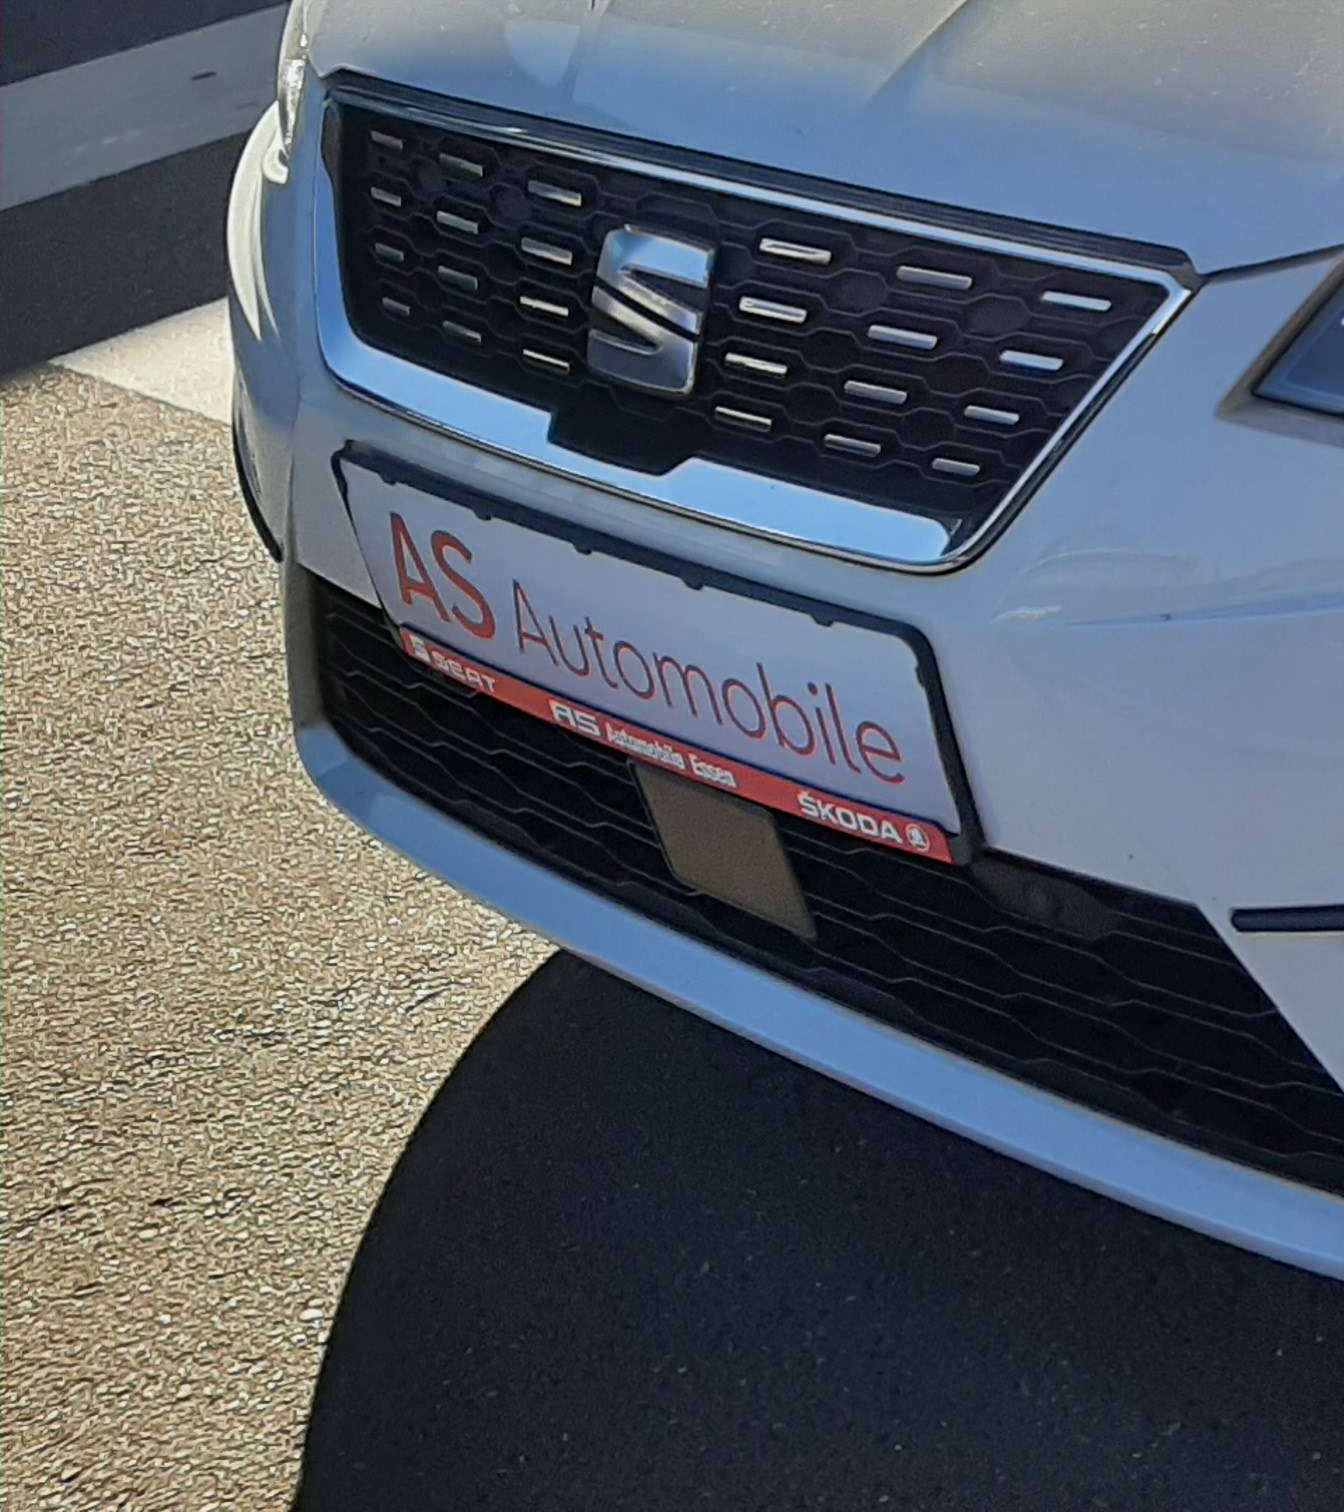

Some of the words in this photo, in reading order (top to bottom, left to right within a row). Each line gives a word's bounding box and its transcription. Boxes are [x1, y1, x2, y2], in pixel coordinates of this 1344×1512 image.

[389, 512, 496, 640] AS
[512, 578, 905, 784] Automobile
[431, 650, 496, 692] SEAT
[549, 699, 601, 736] AS
